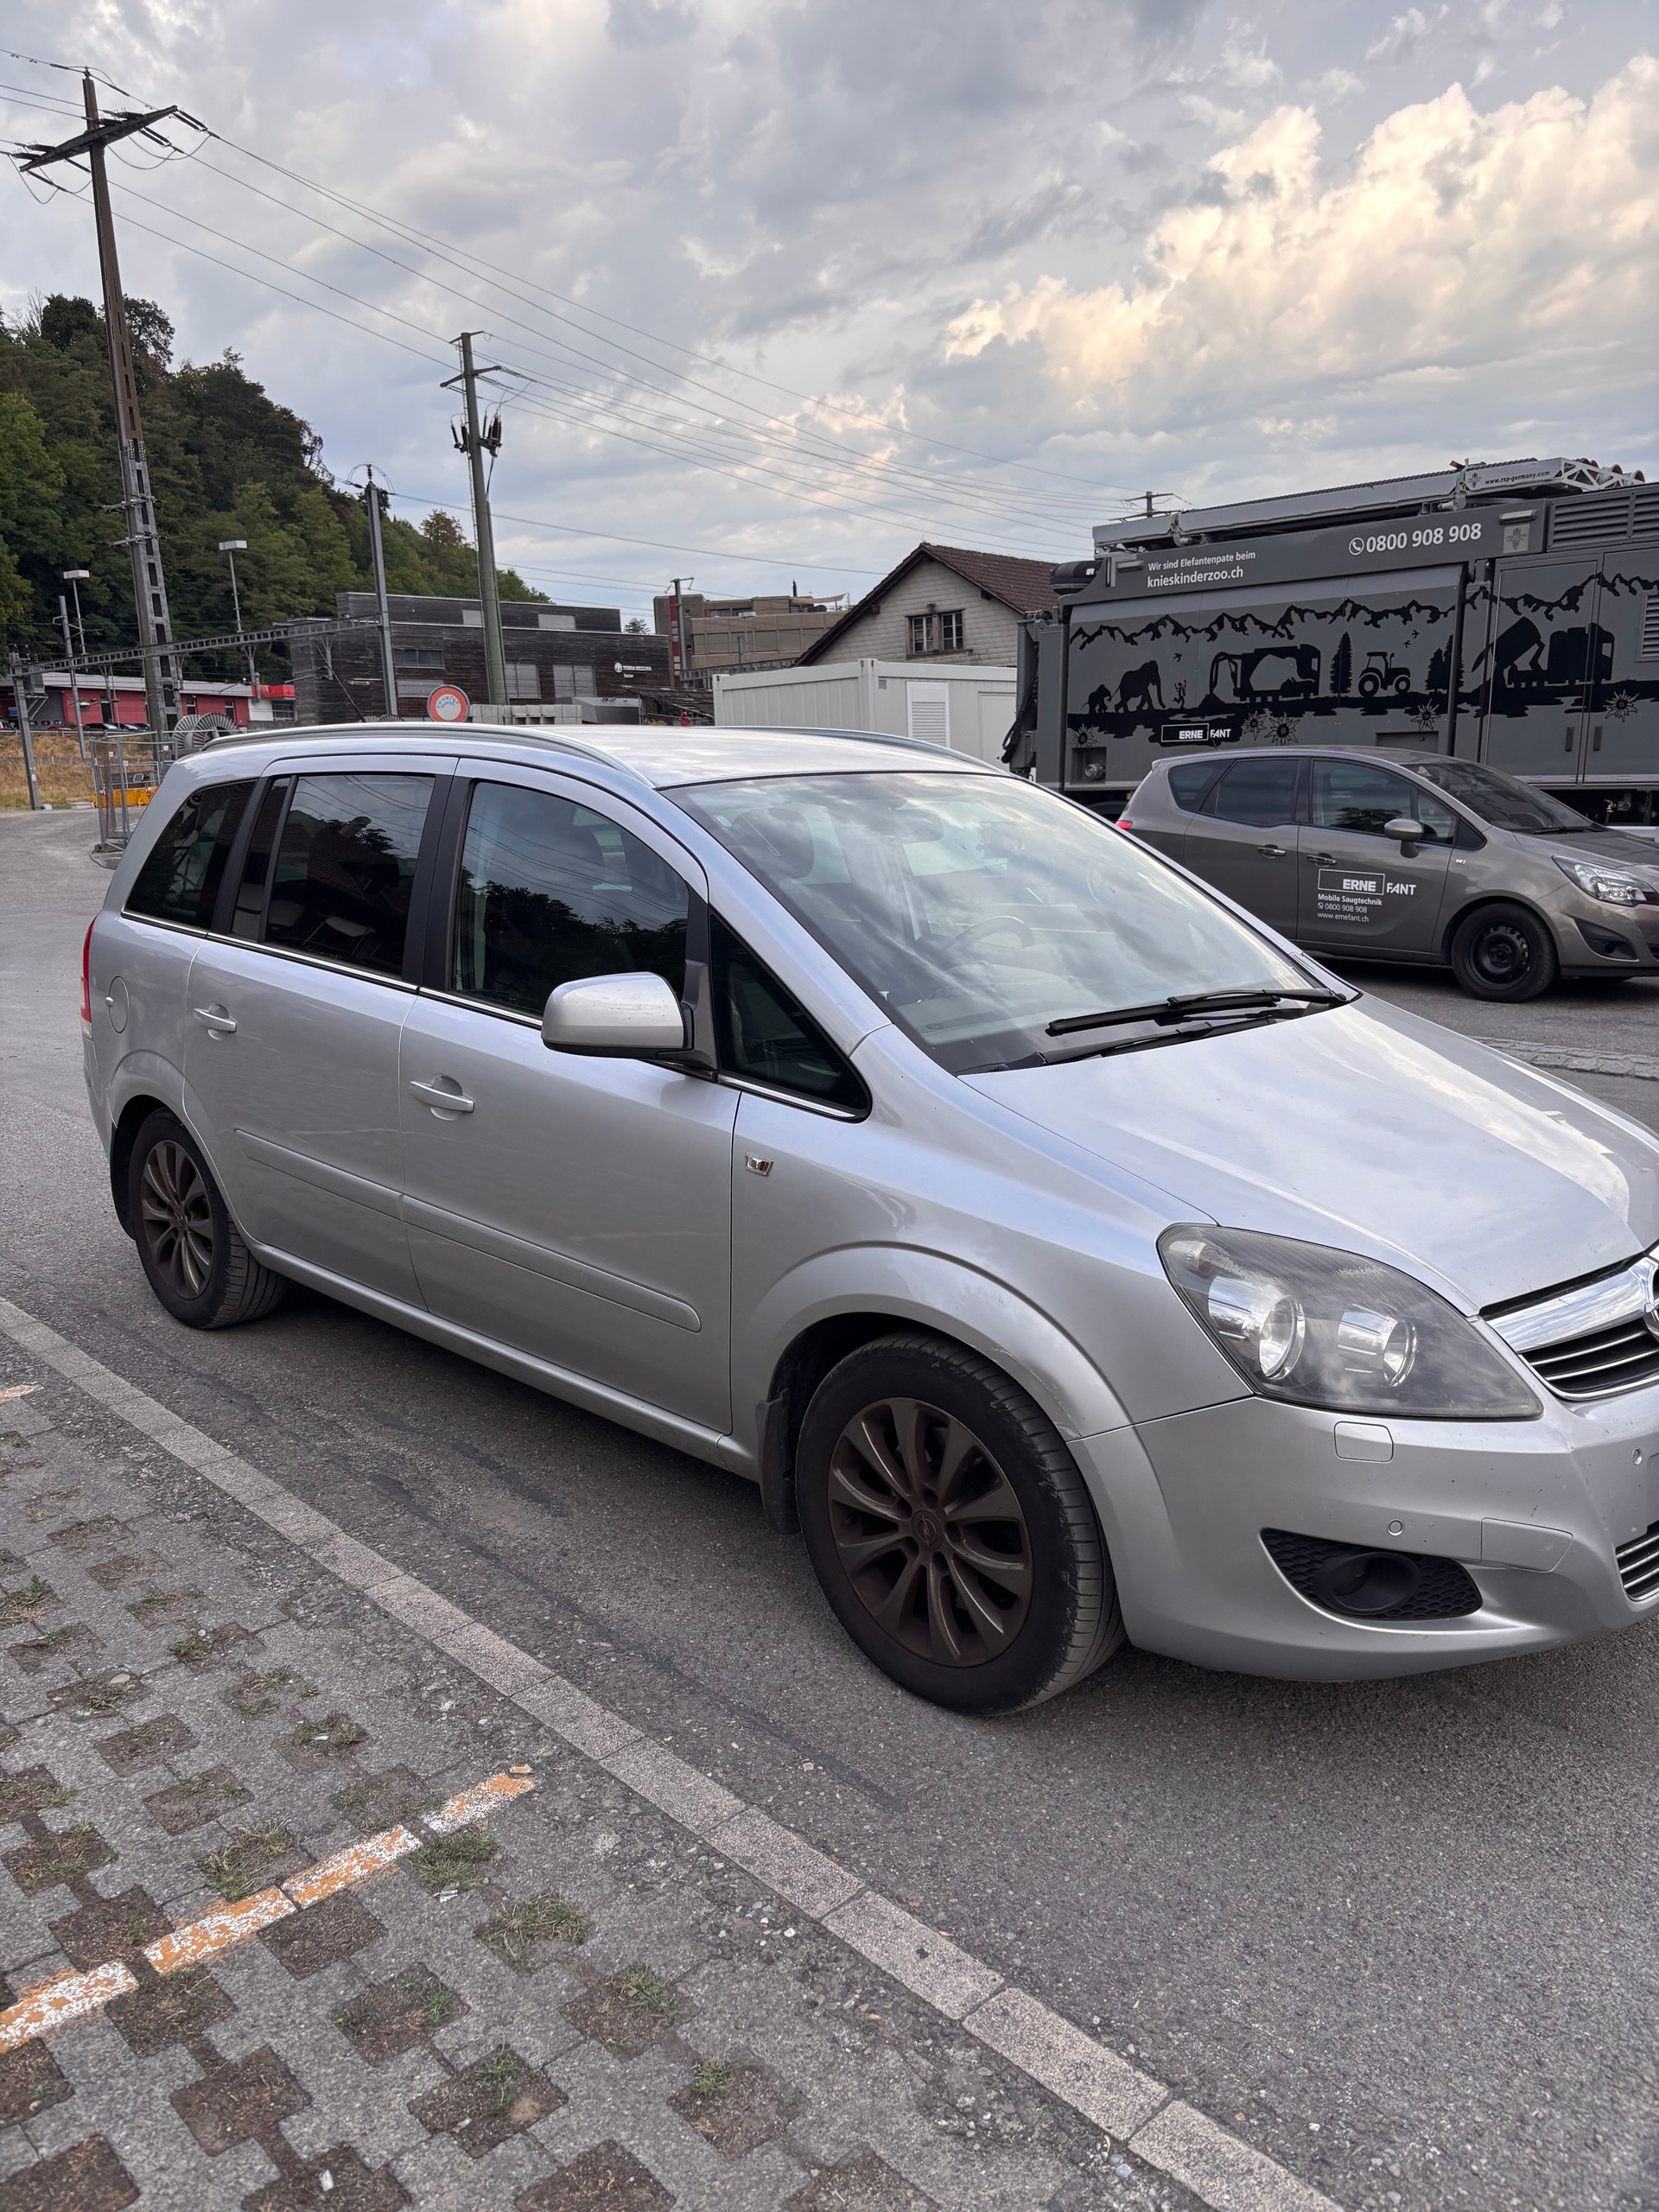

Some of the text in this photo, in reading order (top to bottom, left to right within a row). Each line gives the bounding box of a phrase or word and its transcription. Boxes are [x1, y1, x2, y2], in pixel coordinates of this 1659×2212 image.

[1485, 471, 1550, 485] www.rsp-germany.com
[1366, 523, 1482, 553] 0800 908 908
[1148, 550, 1255, 571] Wir sind Elefantenpate beim
[1147, 566, 1243, 588] knieskinderzoo.ch
[1179, 728, 1231, 740] ERNE FANT
[1343, 878, 1416, 896] ERNE FANT
[1318, 893, 1382, 906] Mobile Saugtechnik
[1342, 904, 1354, 912] 908
[1317, 912, 1370, 923] www.ernefant.ch
